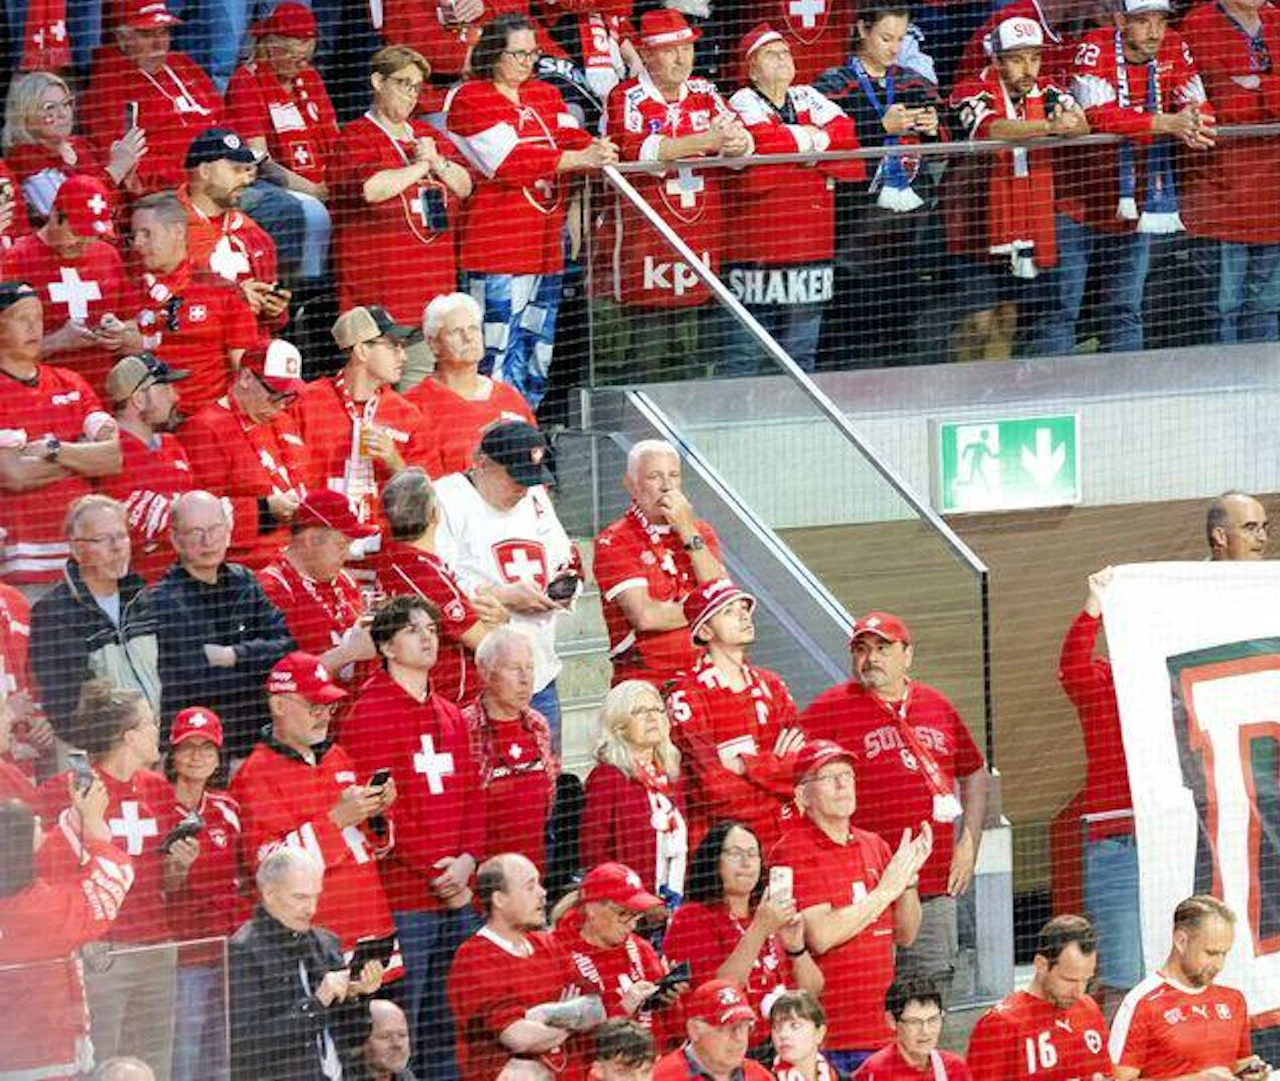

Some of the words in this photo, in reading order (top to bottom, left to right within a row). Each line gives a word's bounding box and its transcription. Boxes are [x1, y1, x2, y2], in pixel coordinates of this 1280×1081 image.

[1013, 23, 1038, 37] SUI
[1074, 42, 1101, 67] 22
[729, 268, 834, 305] SHAKER
[1025, 1030, 1058, 1074] 16
